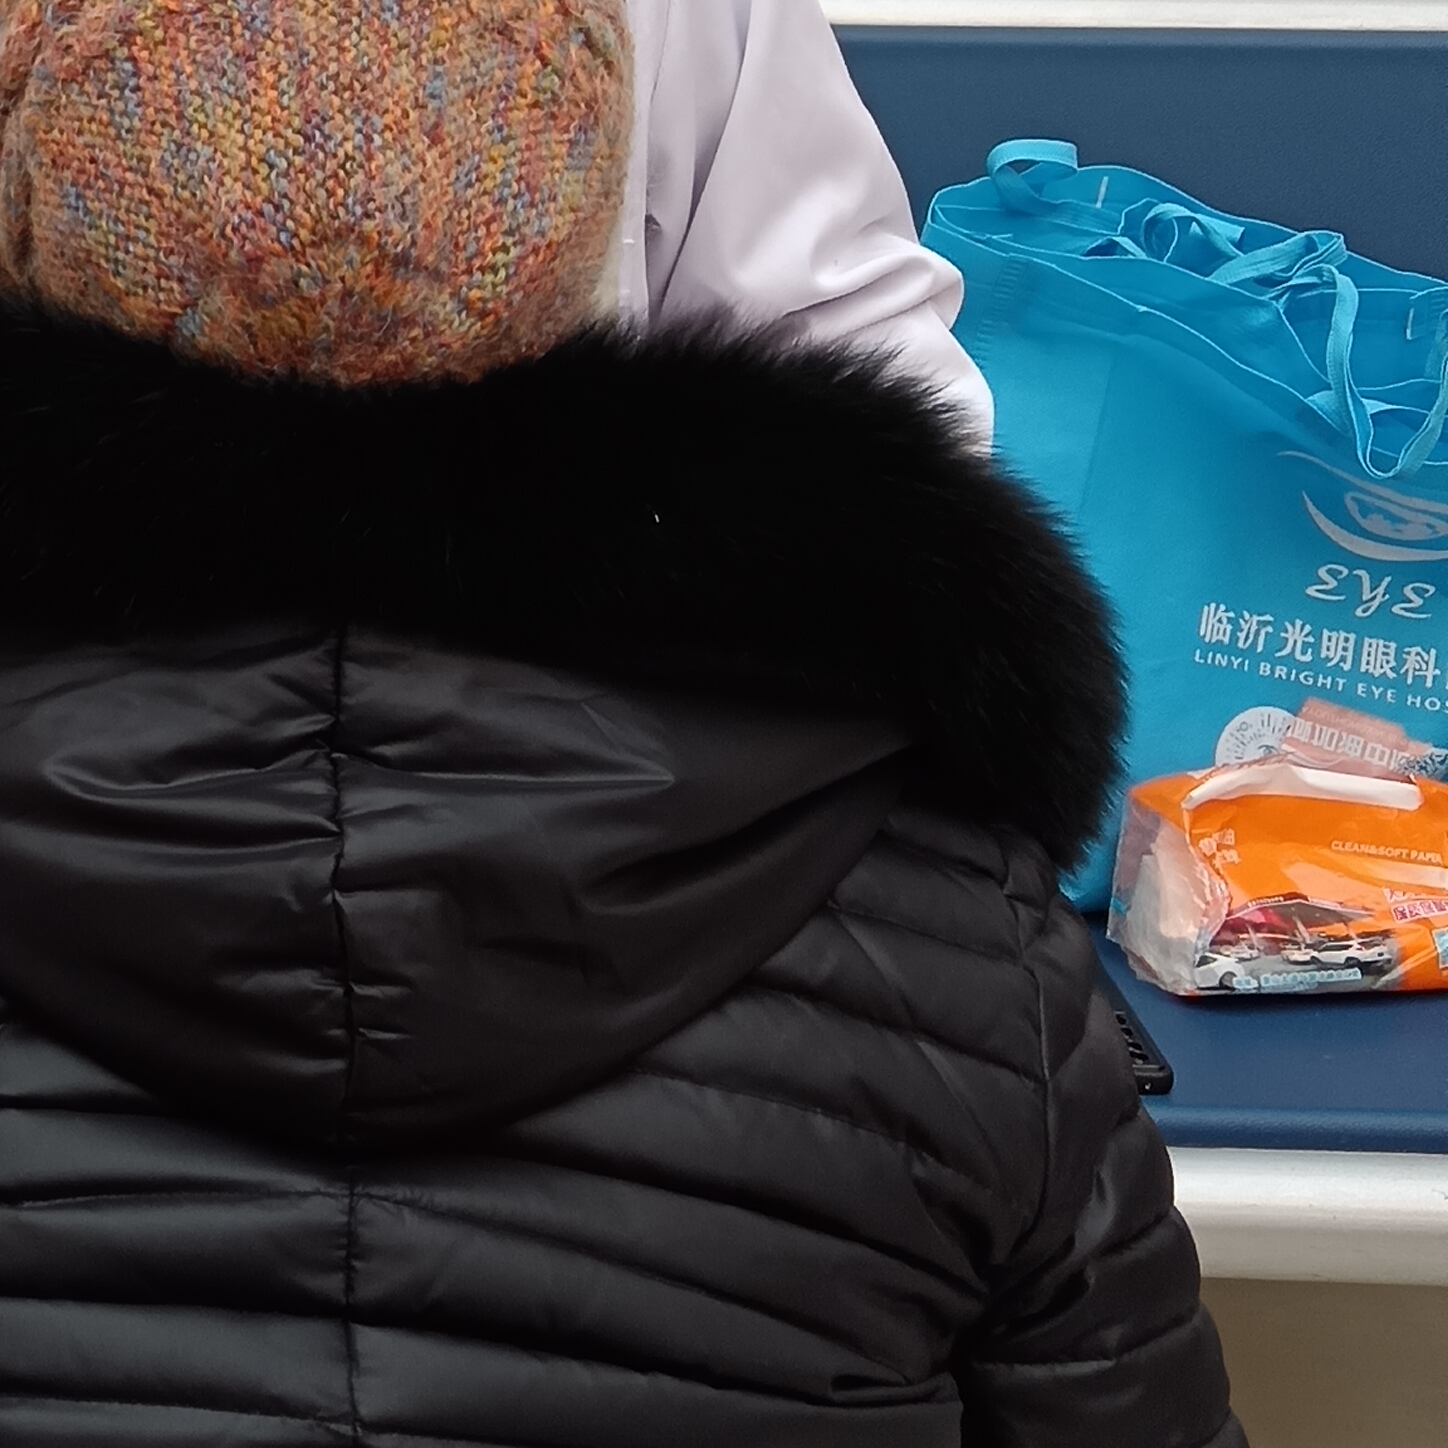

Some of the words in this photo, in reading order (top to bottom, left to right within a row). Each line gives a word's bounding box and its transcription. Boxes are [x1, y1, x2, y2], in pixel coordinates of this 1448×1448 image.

[1194, 649, 1249, 671] LINYI
[1259, 663, 1347, 692] BRIGHT
[1357, 683, 1397, 704] EYE
[1199, 603, 1448, 689] 临沂光明眼科
